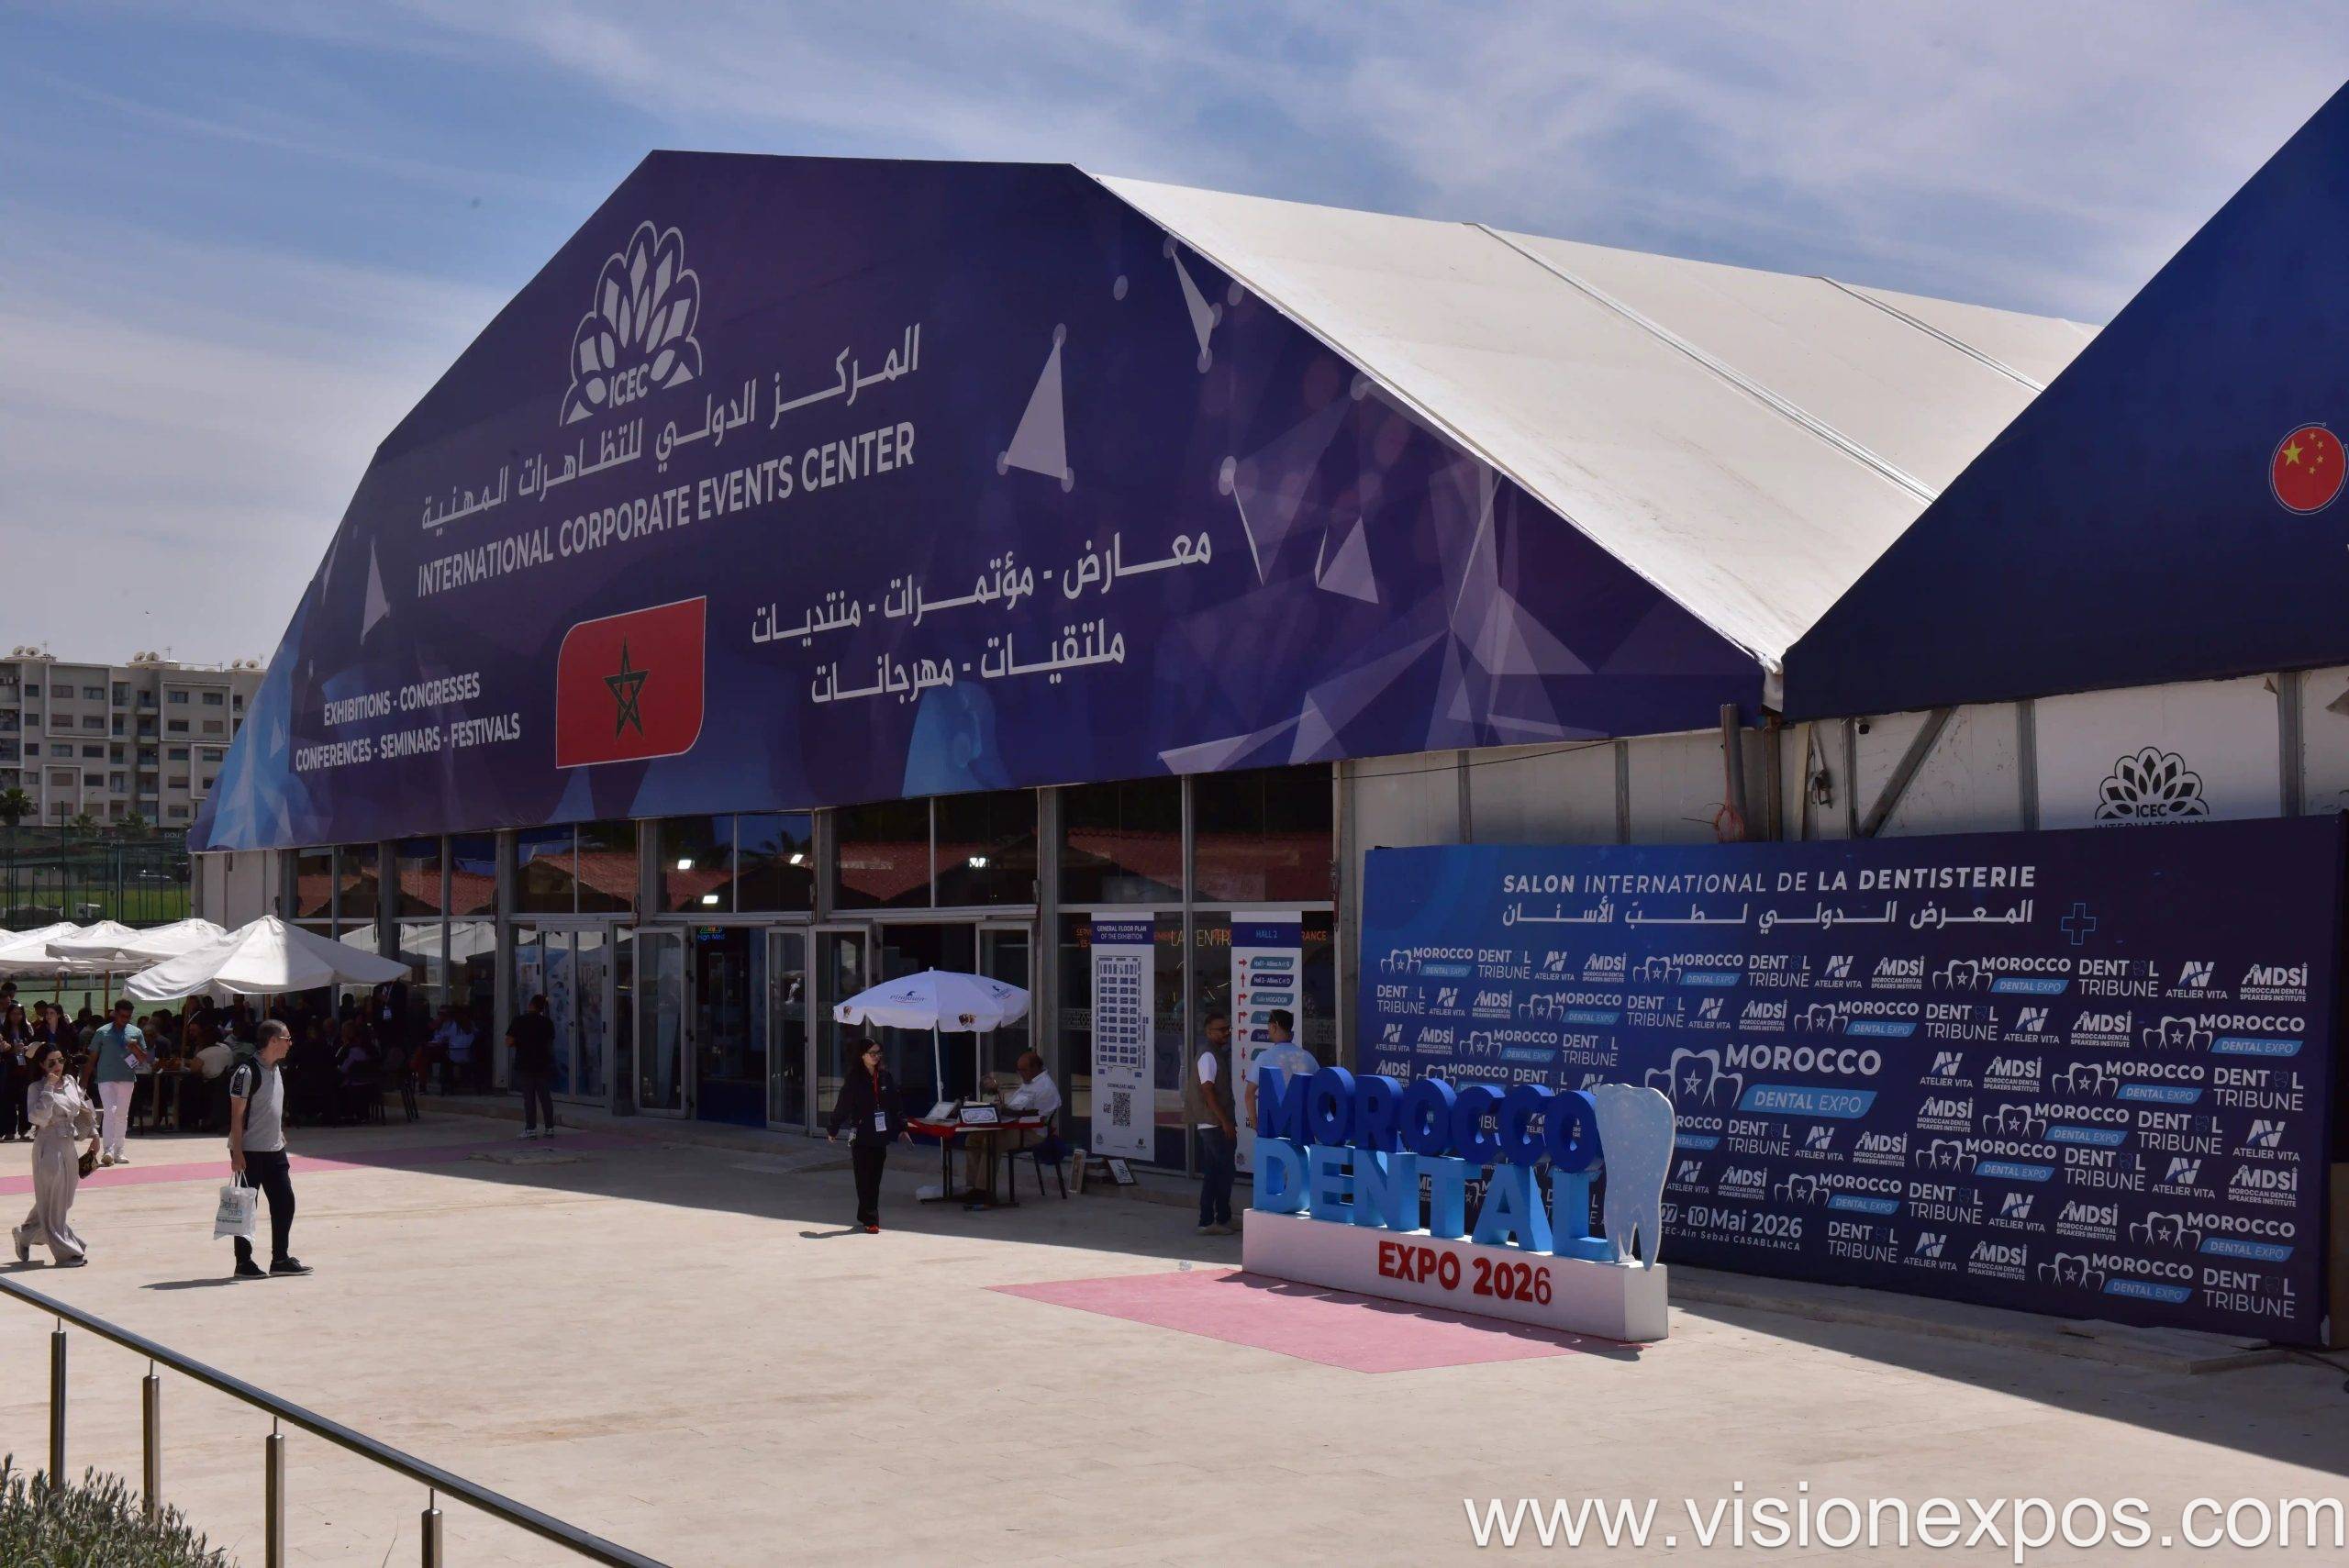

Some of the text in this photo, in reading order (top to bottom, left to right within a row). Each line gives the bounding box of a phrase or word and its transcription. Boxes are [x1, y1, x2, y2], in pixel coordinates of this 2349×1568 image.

[609, 362, 650, 408] ICEC
[417, 421, 915, 597] INTERNATIONAL CORPORATE EVENTS CENTER
[323, 672, 481, 726] EXHIBITIONS CONGRESSES
[295, 714, 520, 773] CONFERENCES SEMINARS FESTIVALS
[2136, 805, 2167, 817] ICEC
[1504, 866, 2035, 893] SALON INTERNATIONAL DE LA DENTISTERIE
[1256, 930, 1272, 939] HALL
[1413, 947, 1474, 959] MOROCCO
[1672, 953, 1743, 967] MOROCCO
[1982, 957, 2071, 972] MOROCCO
[1687, 975, 1735, 984] DENTAL EXPO
[1748, 973, 1809, 987] TRIBUNE
[1814, 980, 1843, 988] ATELIER
[1999, 981, 2061, 992] DENTAL EXPO
[2079, 979, 2158, 997] TRIBUNE
[2165, 989, 2227, 999] ATELIER VITA
[1555, 993, 1621, 1006] MOROCCO
[1839, 1002, 1920, 1016] MOROCCO
[1627, 1012, 1684, 1028] TRIBUNE
[2199, 1014, 2305, 1032] MOROCCO
[1494, 1029, 1557, 1043] MOROCCO
[1854, 1024, 1910, 1035] DENTAL EXPO
[1926, 1023, 1998, 1040] TRIBUNE
[2004, 1033, 2059, 1044] ATELIER VITA
[2221, 1041, 2293, 1053] DENTAL EXPO
[1563, 1051, 1617, 1067] TRIBUNE
[1725, 1044, 1882, 1076] MOROCCO
[1448, 1063, 1508, 1078] MOROCCO
[2106, 1061, 2204, 1080] MOROCCO
[1920, 1077, 1973, 1087] ATELIER VITA
[1754, 1091, 1862, 1113] DENTAL EXPO
[2126, 1087, 2194, 1101] DENTAL EXPO
[2213, 1088, 2303, 1111] TRIBUNE
[1257, 1066, 1604, 1173] MOROCCO
[2035, 1103, 2129, 1123] MOROCCO
[2054, 1129, 2119, 1143] DENTAL EXPO
[2138, 1131, 2222, 1155] TRIBUNE
[1728, 1137, 1789, 1157] TRIBUNE
[1965, 1139, 2056, 1160] MOROCCO
[2232, 1148, 2300, 1162] ATELIER VITA
[1984, 1164, 2046, 1178] DENTAL EXPO
[2065, 1167, 2145, 1191] TRIBUNE
[1820, 1173, 1902, 1193] MOROCCO
[1253, 1136, 1612, 1262] DENTAL
[2153, 1184, 2215, 1199] ATELIER VITA
[1835, 1197, 1892, 1212] DENTAL EXPO
[1909, 1202, 1982, 1225] TRIBUNE
[1710, 1208, 1746, 1231] Mai
[1752, 1213, 1803, 1238] 2026
[1988, 1218, 2045, 1232] ATELIER VITA
[2187, 1212, 2295, 1237] MOROCCO
[1734, 1235, 1800, 1251] CASABLANCA
[2210, 1242, 2284, 1259] DENTAL EXPO
[1828, 1240, 1898, 1263] TRIBUNE
[1904, 1257, 1957, 1271] ATELIER VITA
[2092, 1253, 2194, 1280] MOROCCO
[1378, 1240, 1553, 1305] EXPO 2026
[2113, 1283, 2183, 1300] DENTAL EXPO
[2203, 1289, 2294, 1318] TRIBUNE
